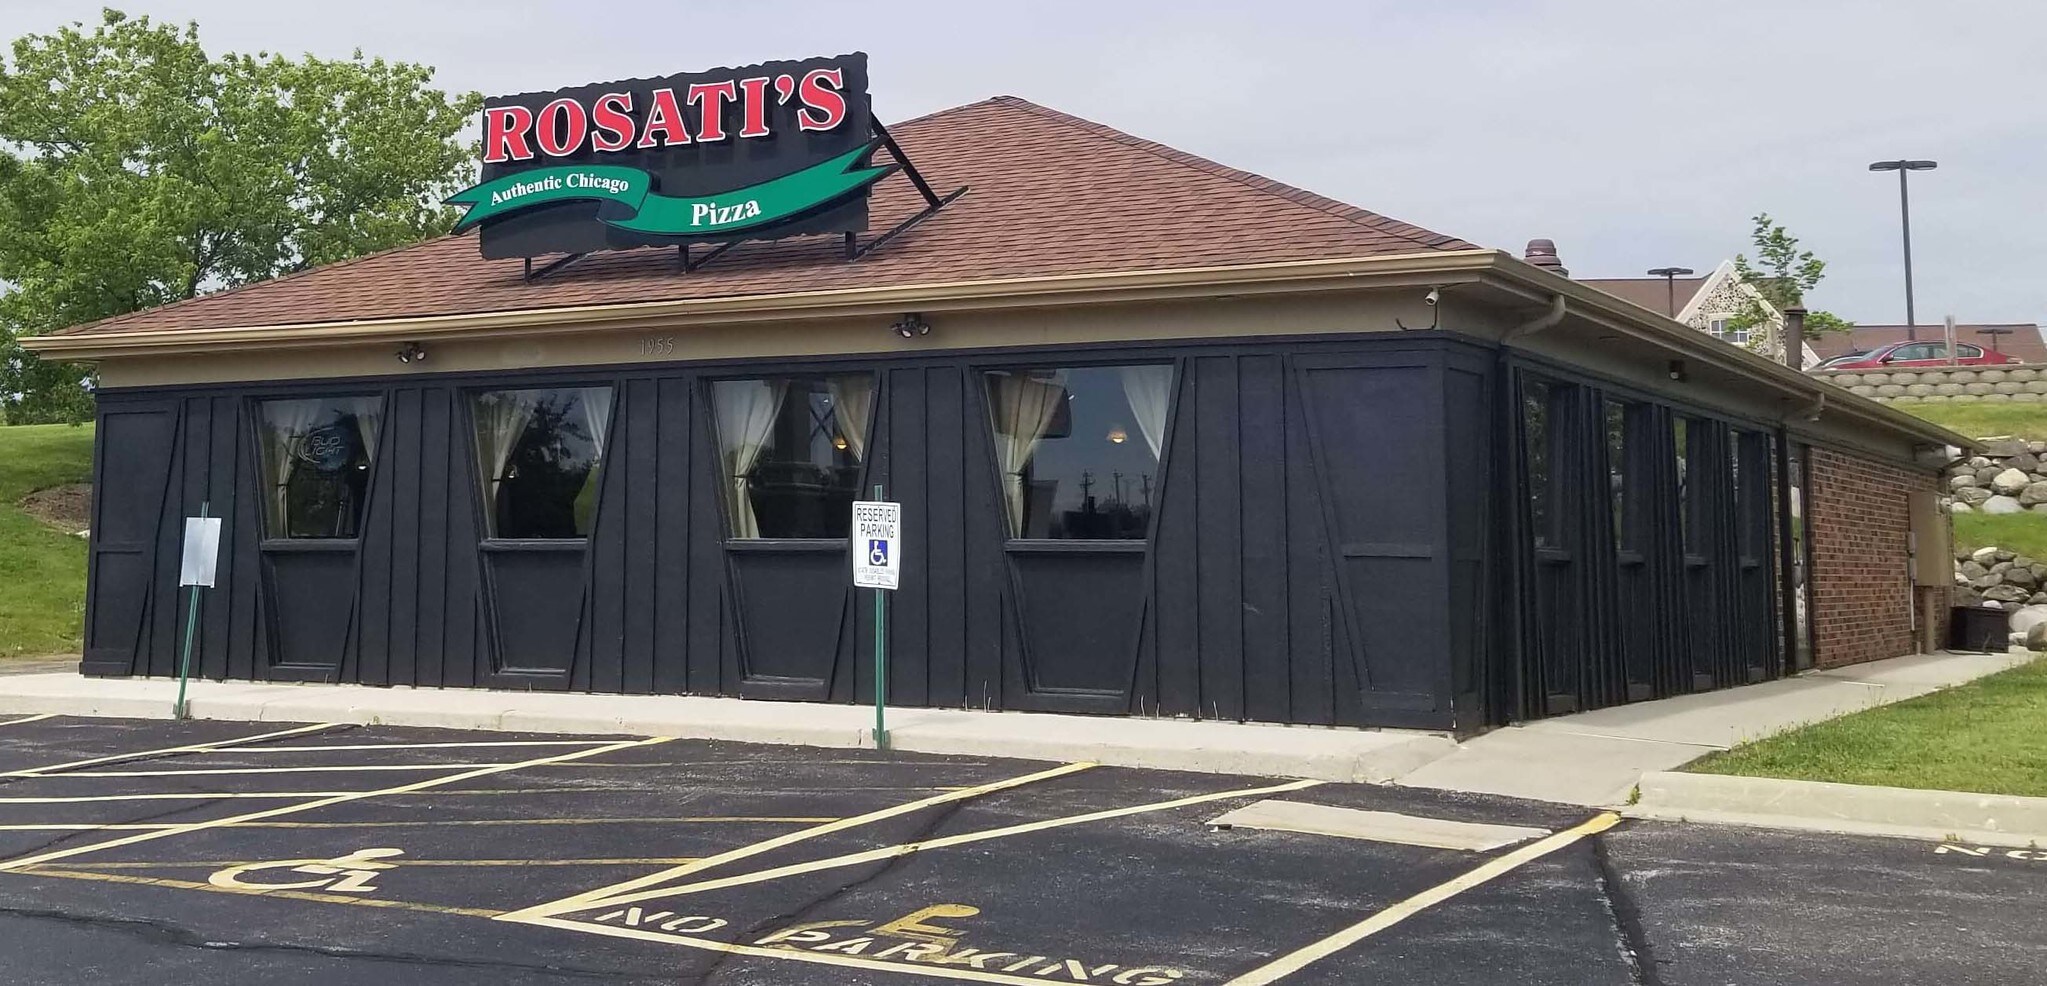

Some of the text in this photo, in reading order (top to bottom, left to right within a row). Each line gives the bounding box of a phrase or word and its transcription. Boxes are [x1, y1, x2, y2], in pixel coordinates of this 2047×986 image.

[484, 67, 846, 163] ROSATI'S
[491, 173, 629, 206] Authentic Chicago
[690, 200, 761, 226] Pizza
[641, 337, 673, 356] 1955
[310, 435, 341, 446] BUD
[857, 507, 897, 523] RESERVED
[860, 523, 895, 538] PARKING
[594, 906, 1183, 986] NO PARKING
